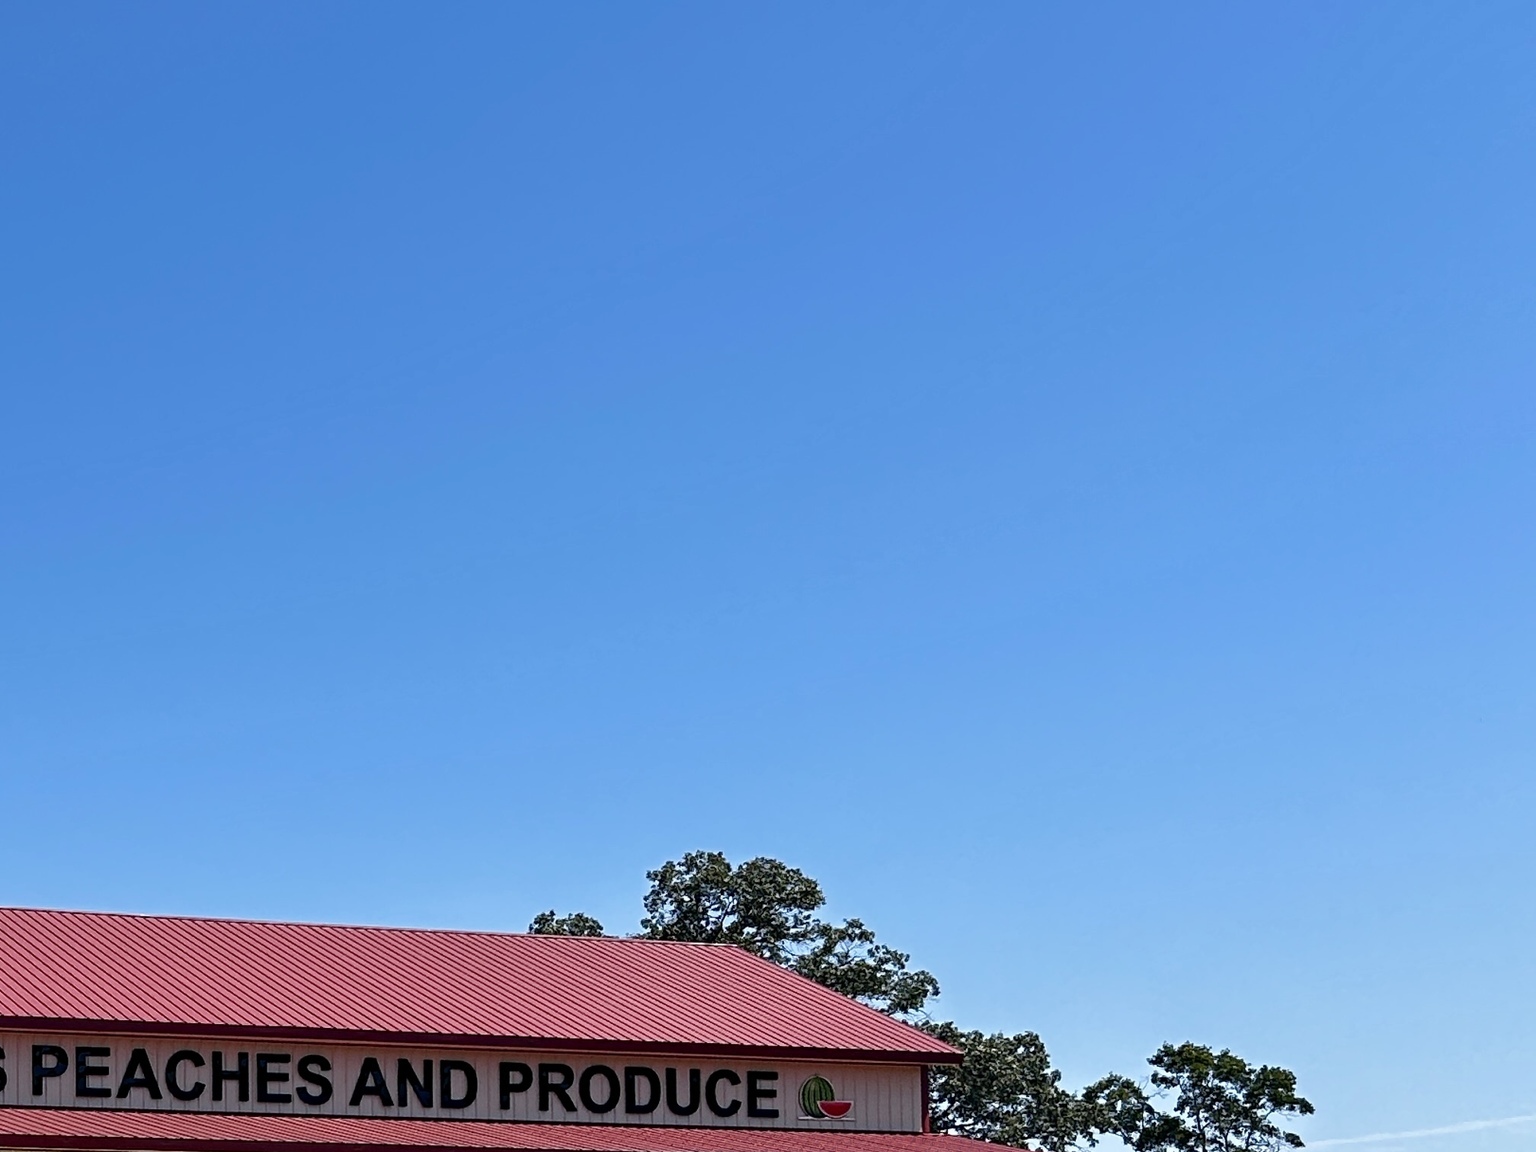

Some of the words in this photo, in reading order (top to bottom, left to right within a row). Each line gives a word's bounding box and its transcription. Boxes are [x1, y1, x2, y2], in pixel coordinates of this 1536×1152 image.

[32, 1044, 332, 1106] PEACHES
[350, 1057, 478, 1110] AND
[499, 1061, 779, 1119] PRODUCE
